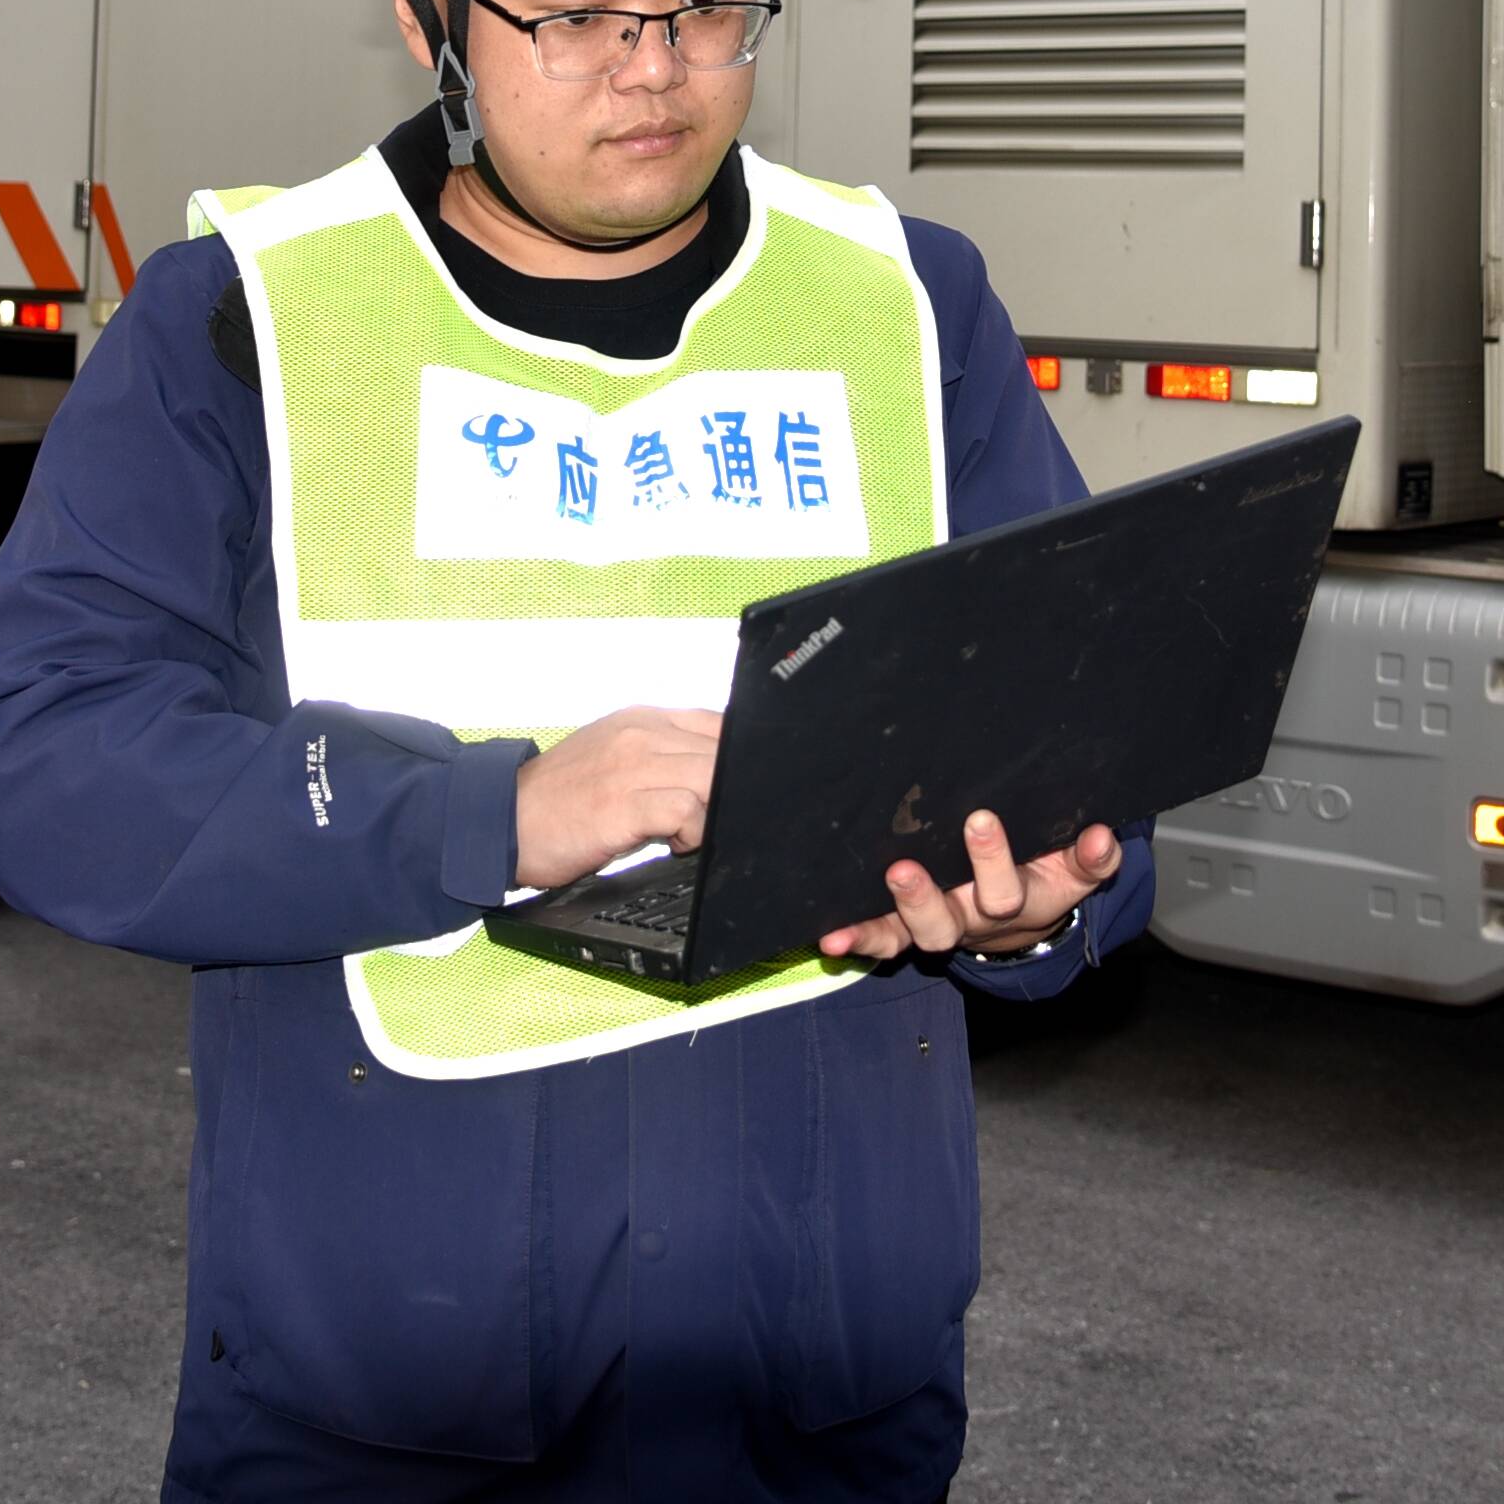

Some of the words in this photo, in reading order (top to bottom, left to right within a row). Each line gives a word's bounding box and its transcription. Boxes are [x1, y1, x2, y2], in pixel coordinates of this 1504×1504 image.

[555, 410, 832, 526] 应急通信
[770, 616, 844, 681] ThinkPad
[306, 741, 330, 827] SUPER-TEX
